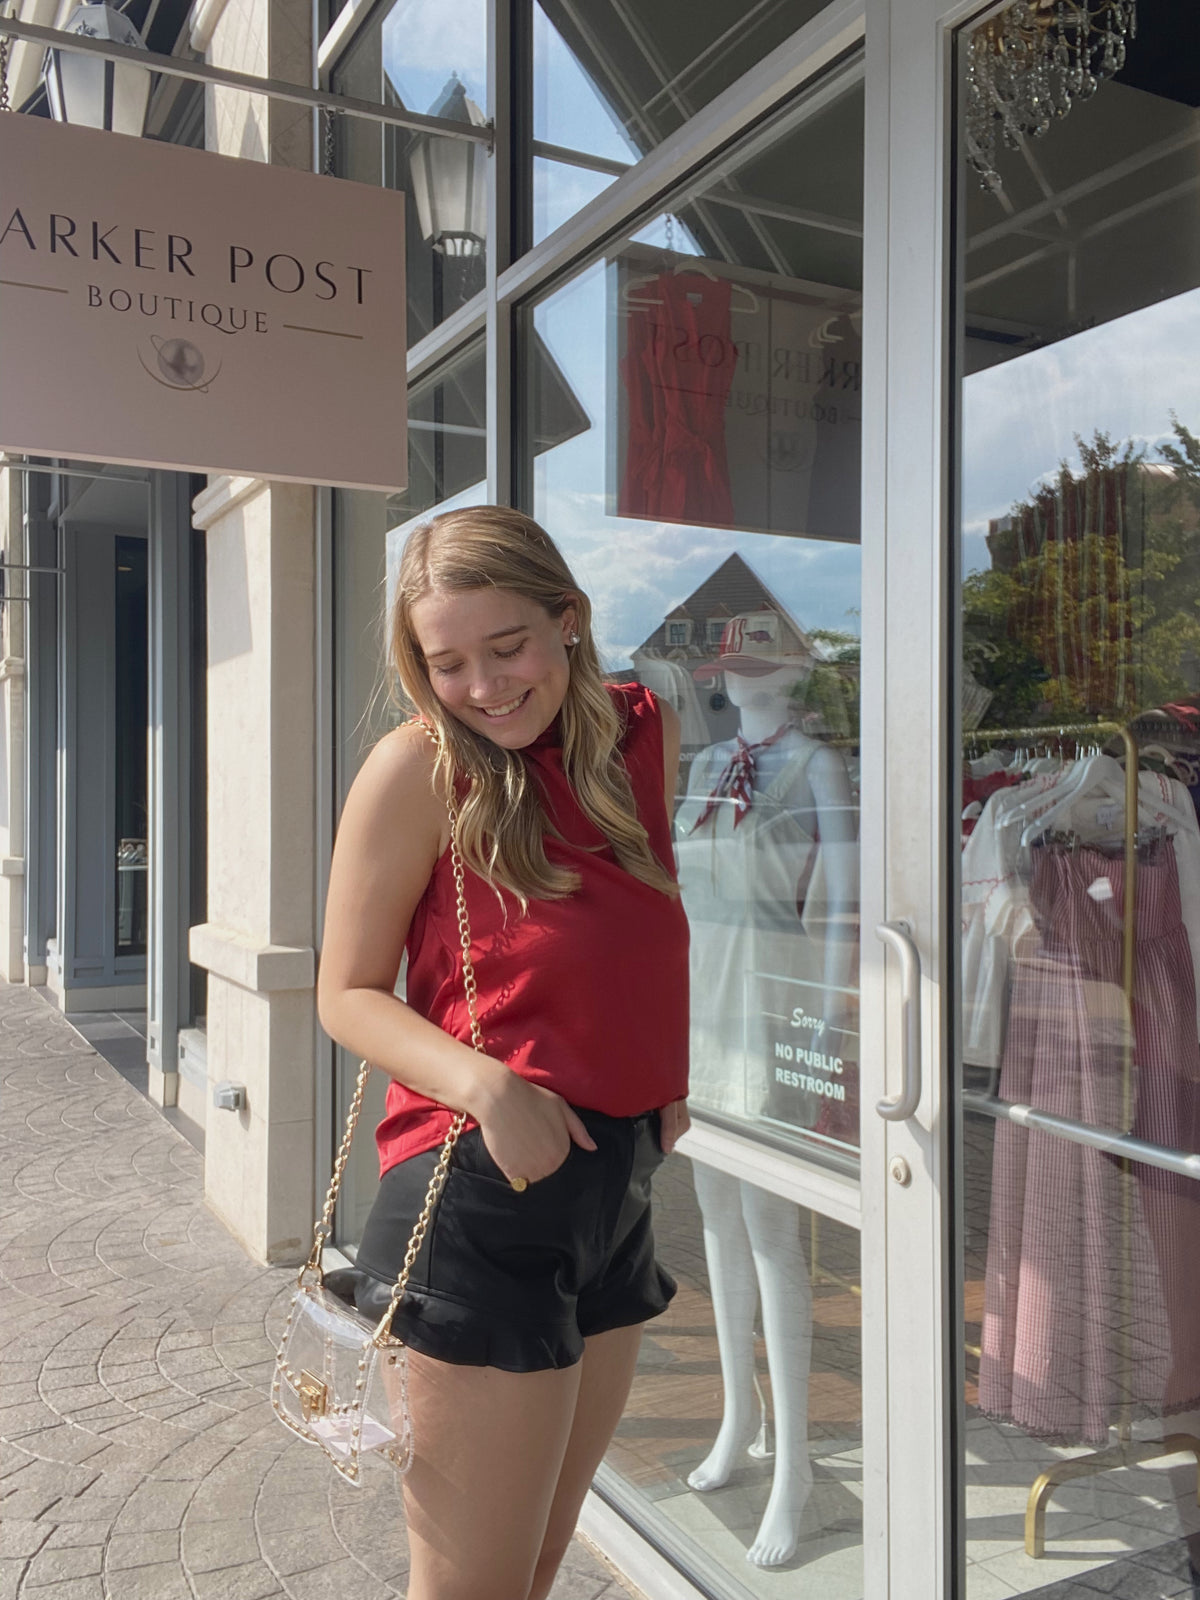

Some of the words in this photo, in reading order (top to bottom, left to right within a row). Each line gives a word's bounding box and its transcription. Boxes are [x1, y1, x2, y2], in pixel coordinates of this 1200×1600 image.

[0, 207, 197, 277] ARKER
[228, 245, 373, 305] POST
[87, 284, 269, 335] BOUTIQUE
[790, 1007, 825, 1036] Sorry
[775, 1042, 793, 1060] NO
[796, 1047, 843, 1074] PUBLIC
[775, 1067, 845, 1101] RESTROOM
